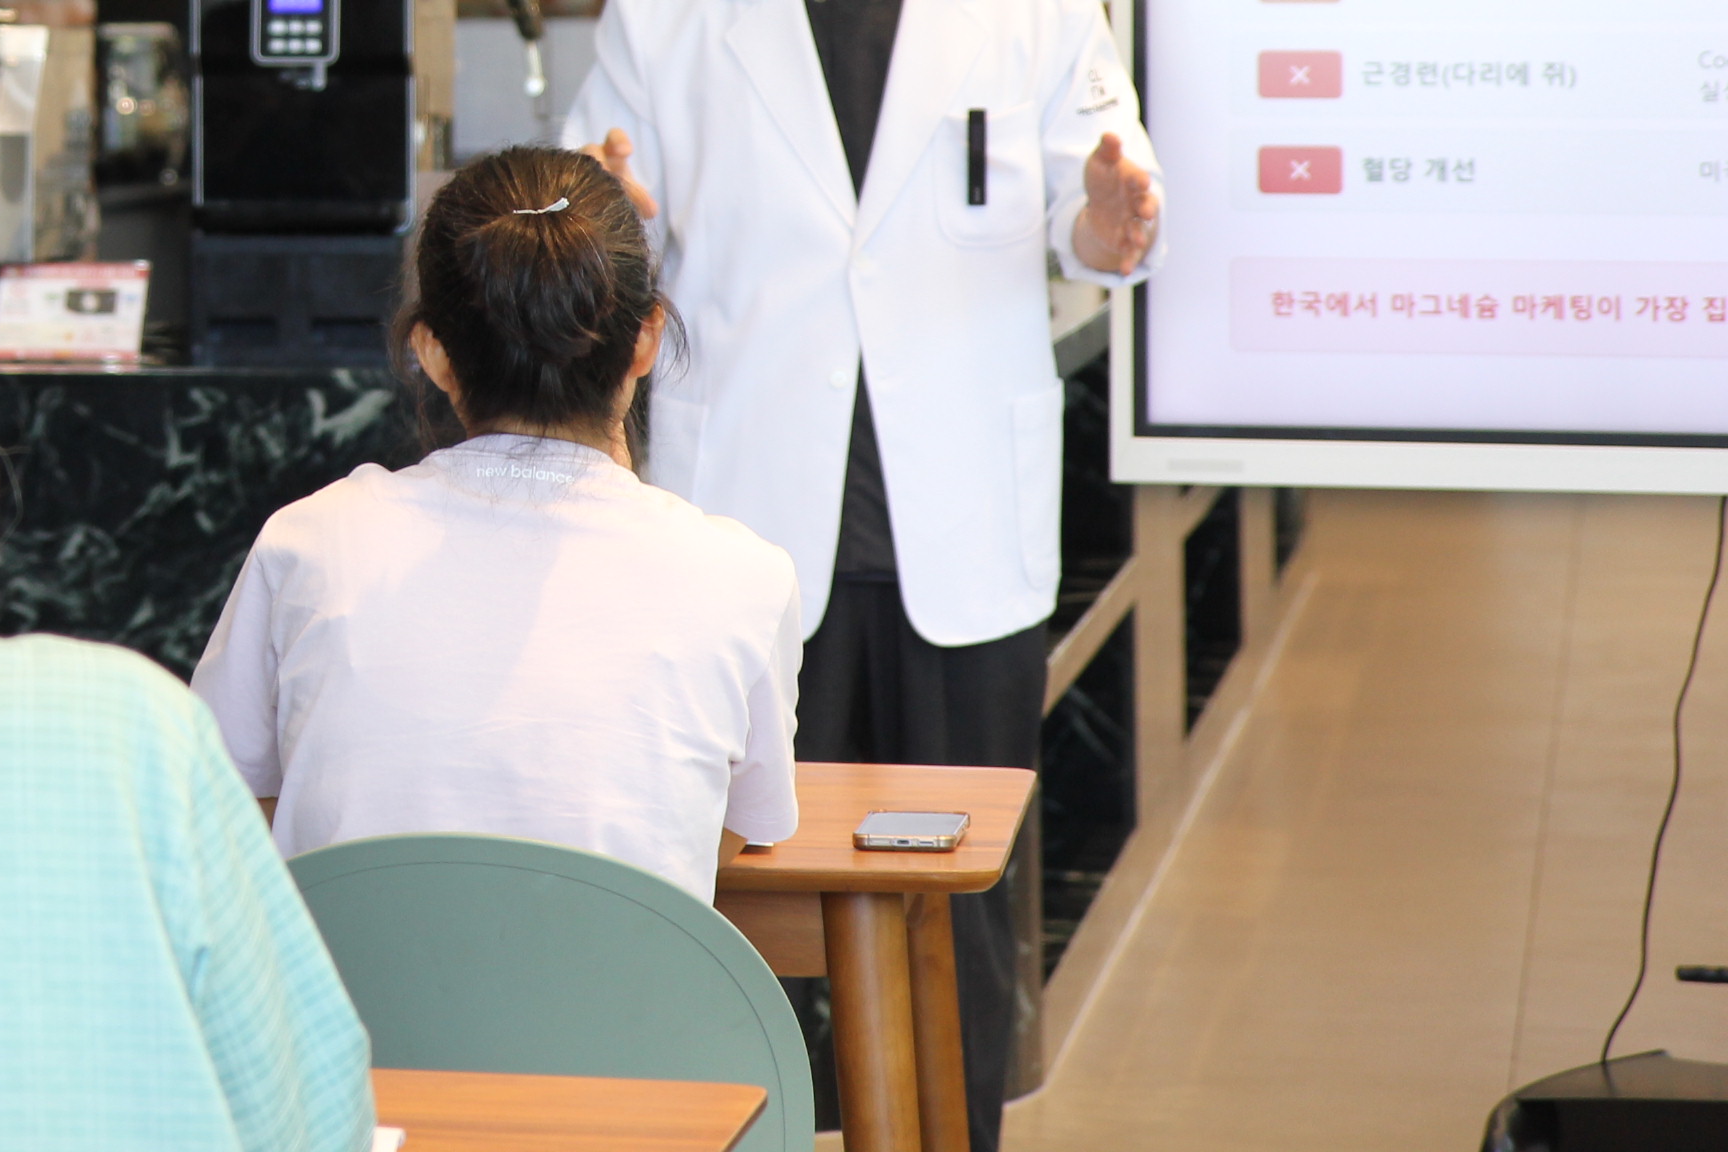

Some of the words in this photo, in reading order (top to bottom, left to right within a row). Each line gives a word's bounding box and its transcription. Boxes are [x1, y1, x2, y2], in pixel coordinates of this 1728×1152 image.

[1362, 62, 1530, 88] 근경련(다리에
[1542, 62, 1577, 88] 쥐)
[1363, 158, 1412, 182] 혈당
[1426, 158, 1474, 183] 개선
[1272, 291, 1378, 317] 한국에서
[1392, 294, 1499, 320] 마그네슘
[1513, 295, 1622, 321] 마케팅이
[1636, 296, 1690, 323] 가장
[476, 467, 507, 478] new
[511, 464, 575, 484] balance
